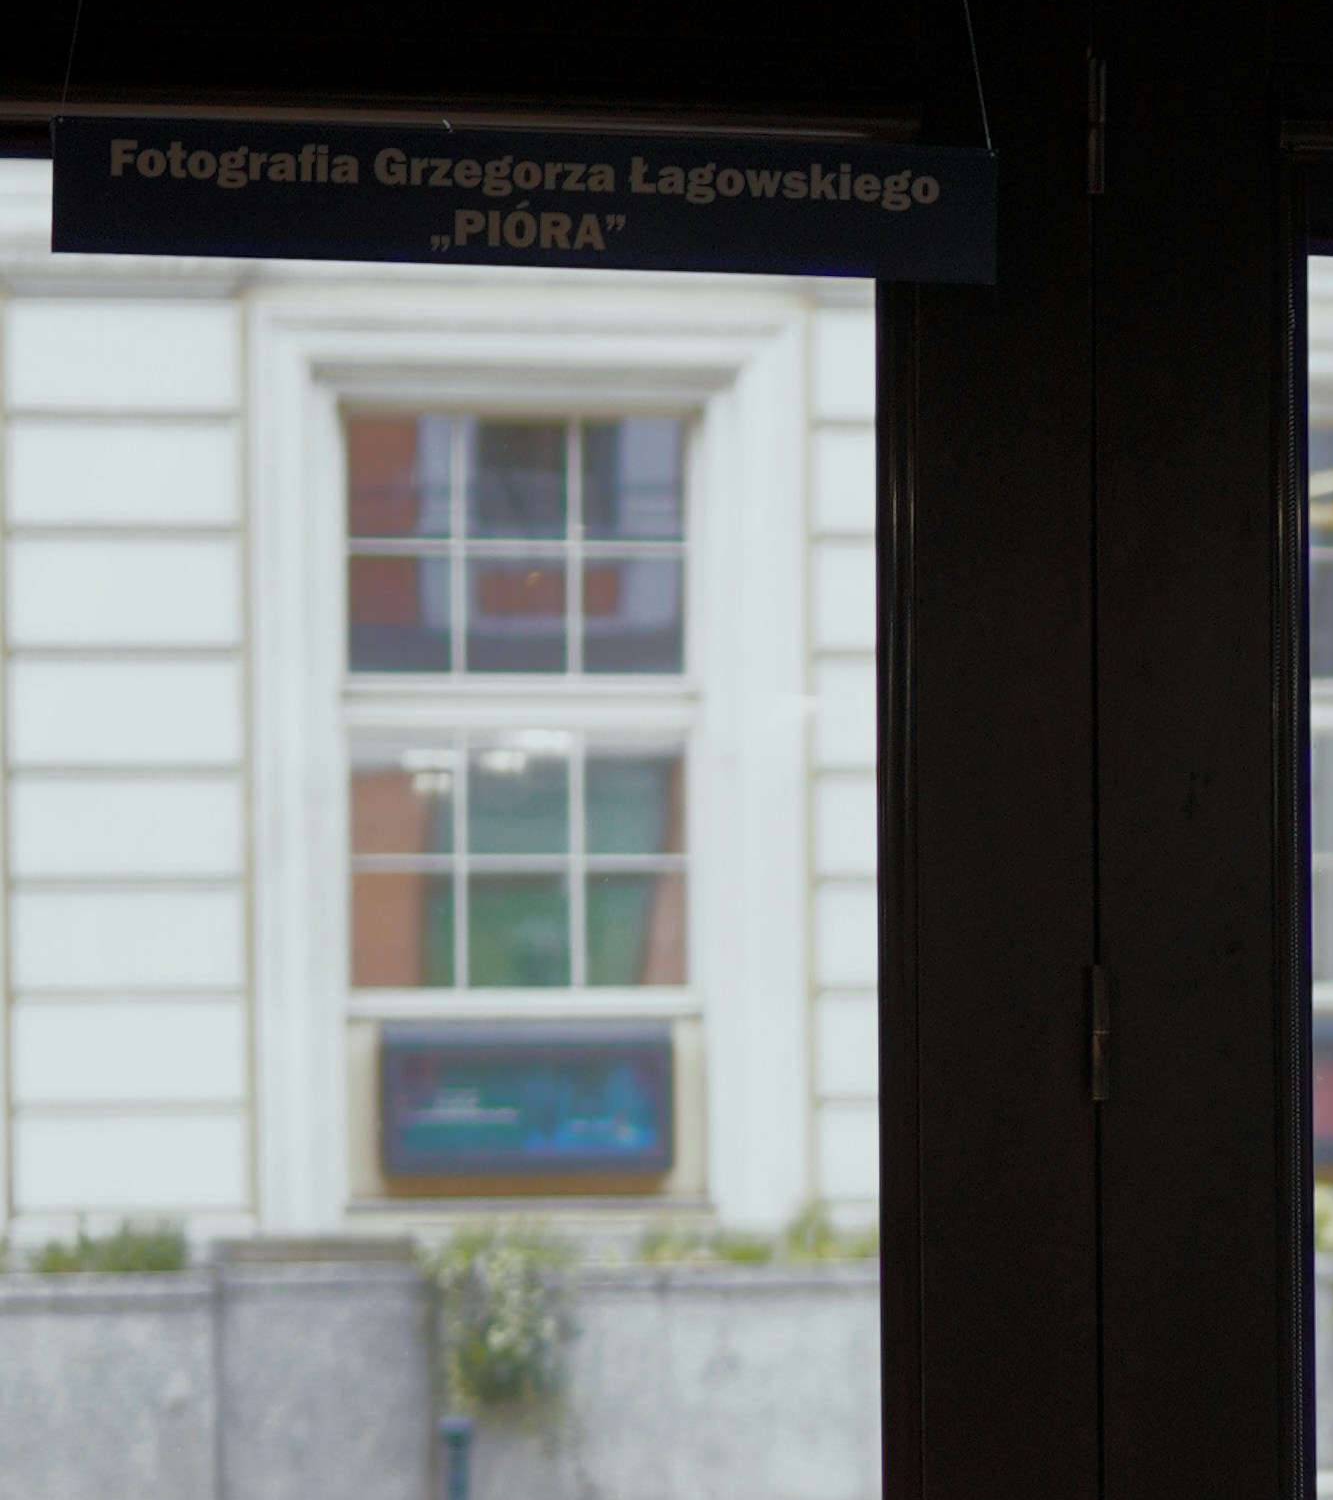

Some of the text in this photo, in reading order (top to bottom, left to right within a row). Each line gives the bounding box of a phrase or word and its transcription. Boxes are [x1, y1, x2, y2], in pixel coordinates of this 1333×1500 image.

[109, 138, 941, 212] Fotografia Grzegorza Łagowskiego
[430, 199, 626, 252] „PIÓRA”
